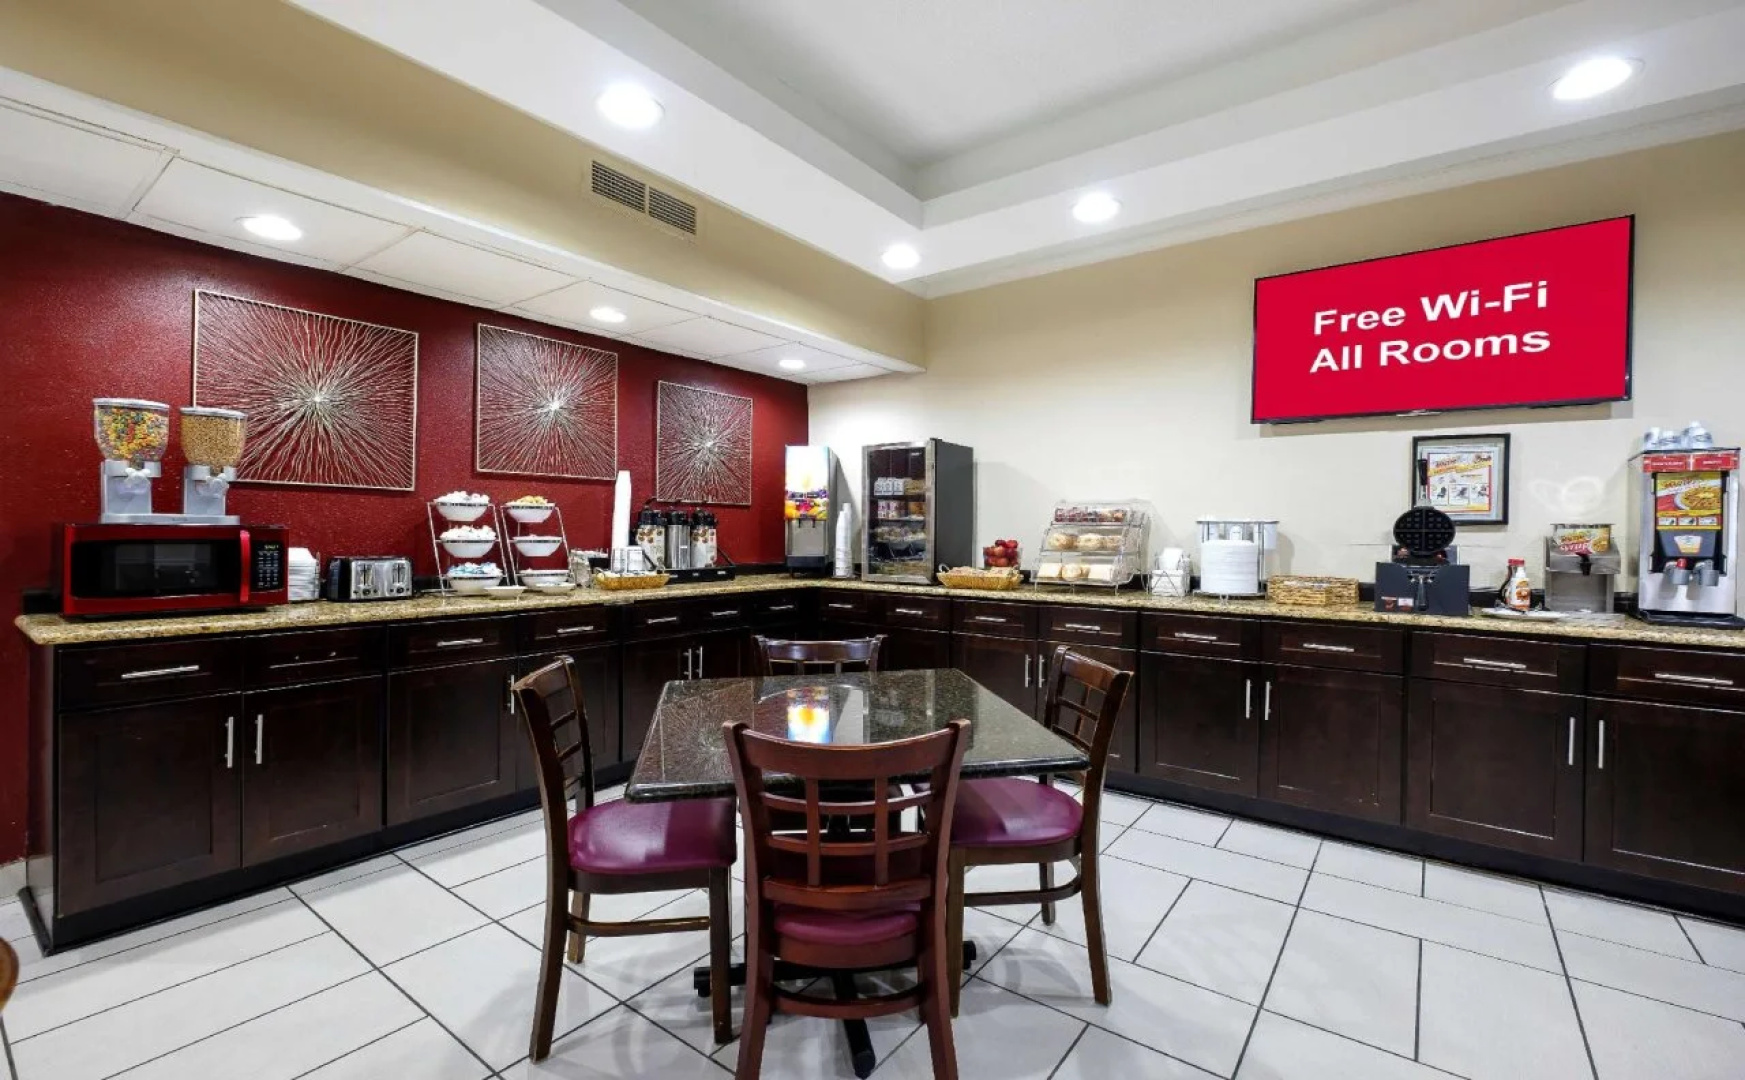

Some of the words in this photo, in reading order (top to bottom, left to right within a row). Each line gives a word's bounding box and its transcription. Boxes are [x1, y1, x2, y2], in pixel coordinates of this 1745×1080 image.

[1314, 307, 1406, 335] Free
[1420, 280, 1547, 322] Wi-Fi
[1309, 344, 1363, 373] All
[1379, 330, 1551, 367] Rooms
